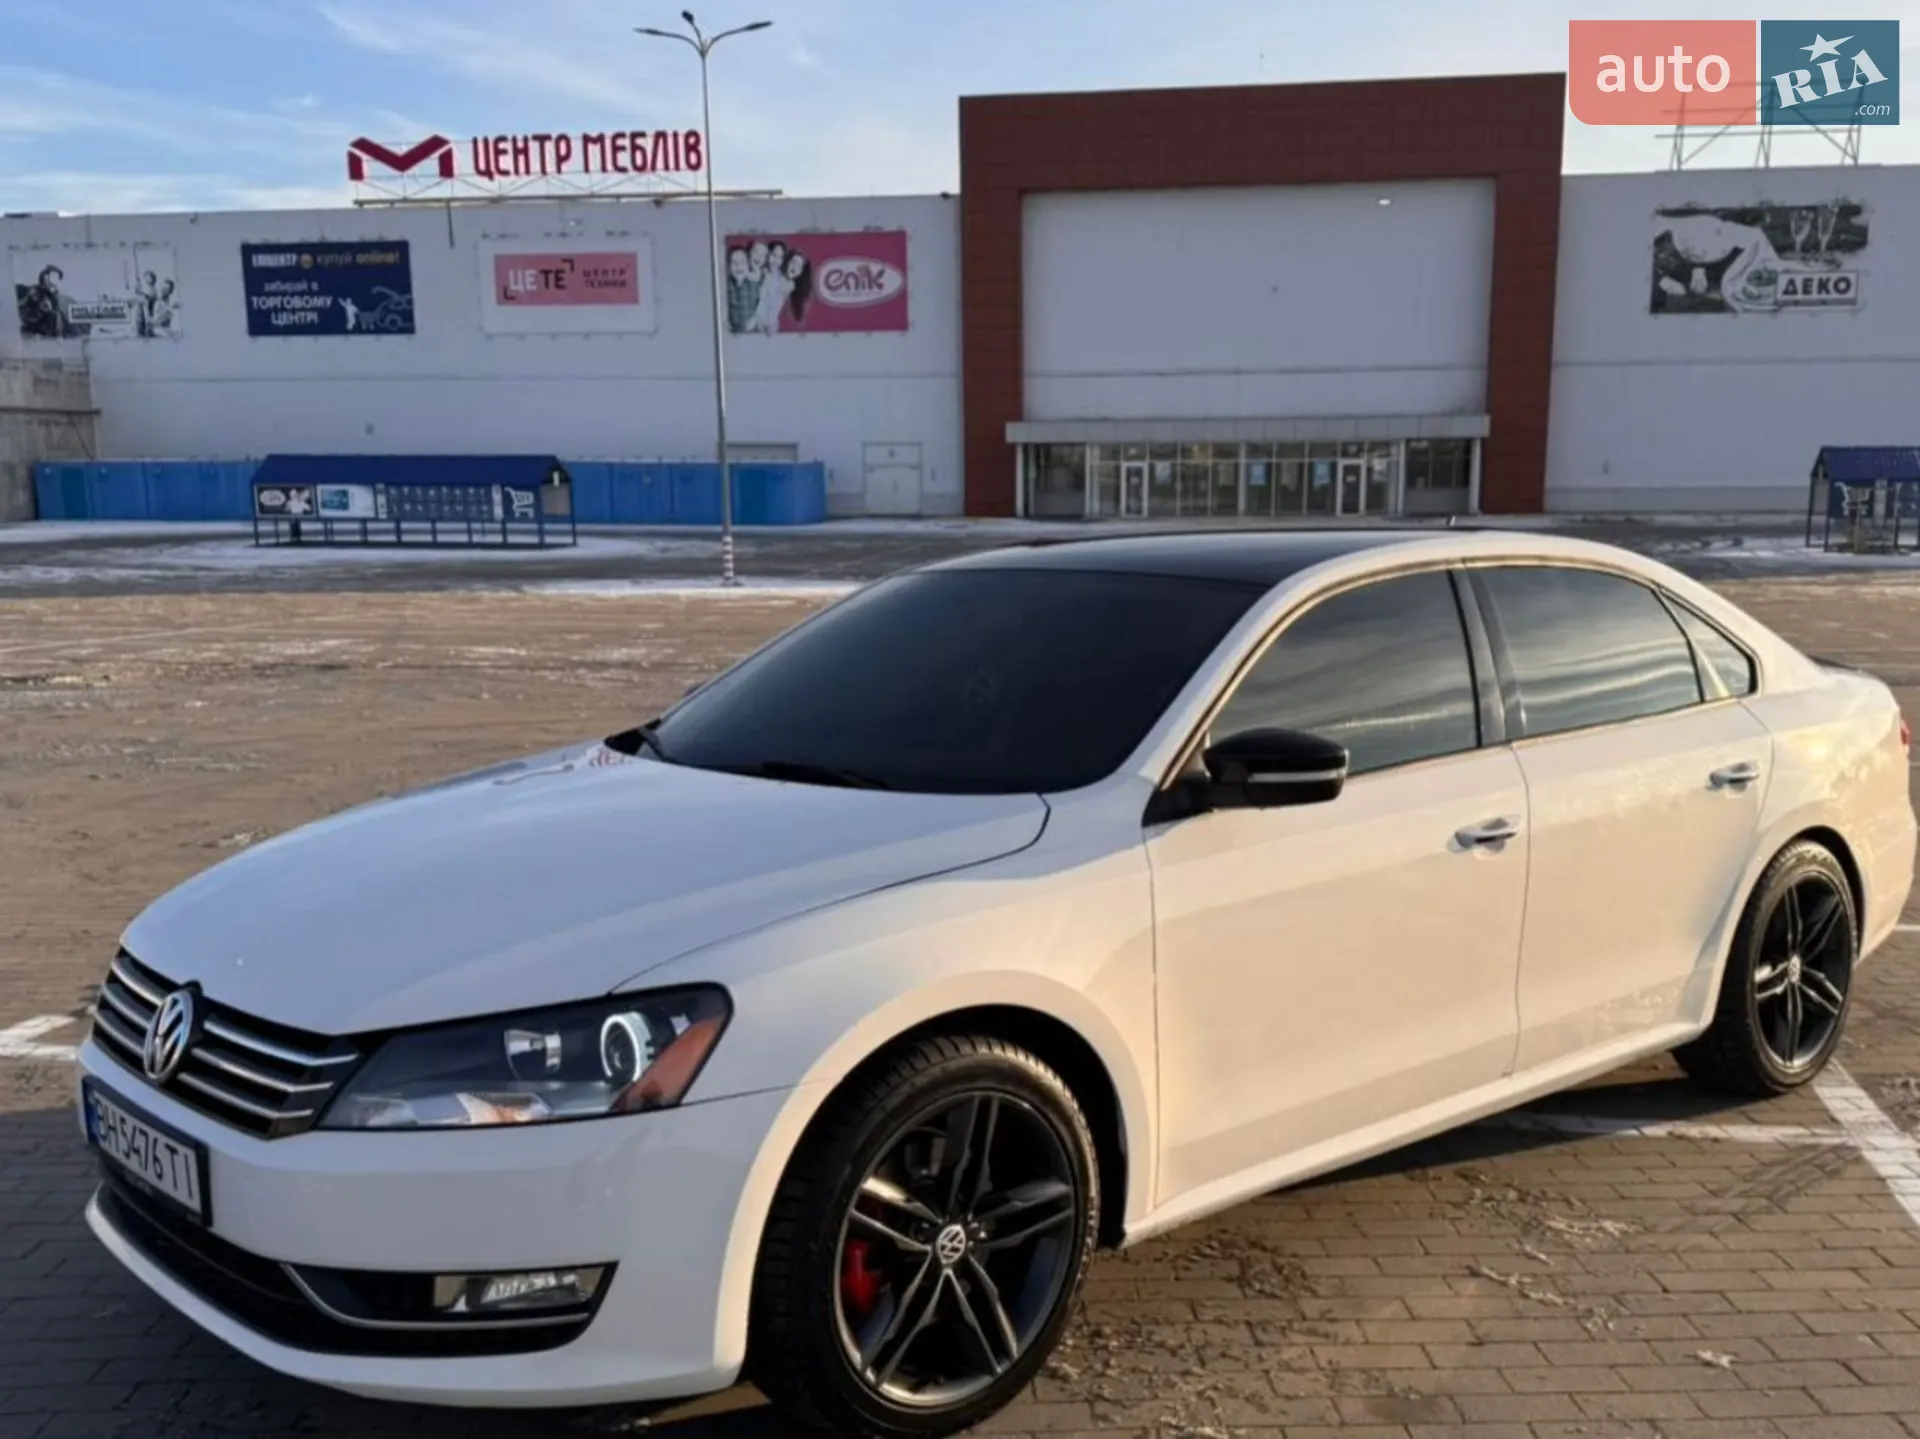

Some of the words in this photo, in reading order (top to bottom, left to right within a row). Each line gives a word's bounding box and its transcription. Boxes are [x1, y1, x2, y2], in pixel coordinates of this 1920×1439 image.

[472, 134, 572, 181] ЦЕНТР
[581, 129, 703, 174] МЕБЛІВ
[1782, 276, 1851, 296] ДЕКО
[251, 296, 333, 309] ТОРГОВОМУ
[270, 312, 319, 327] ЦЕНТРІ
